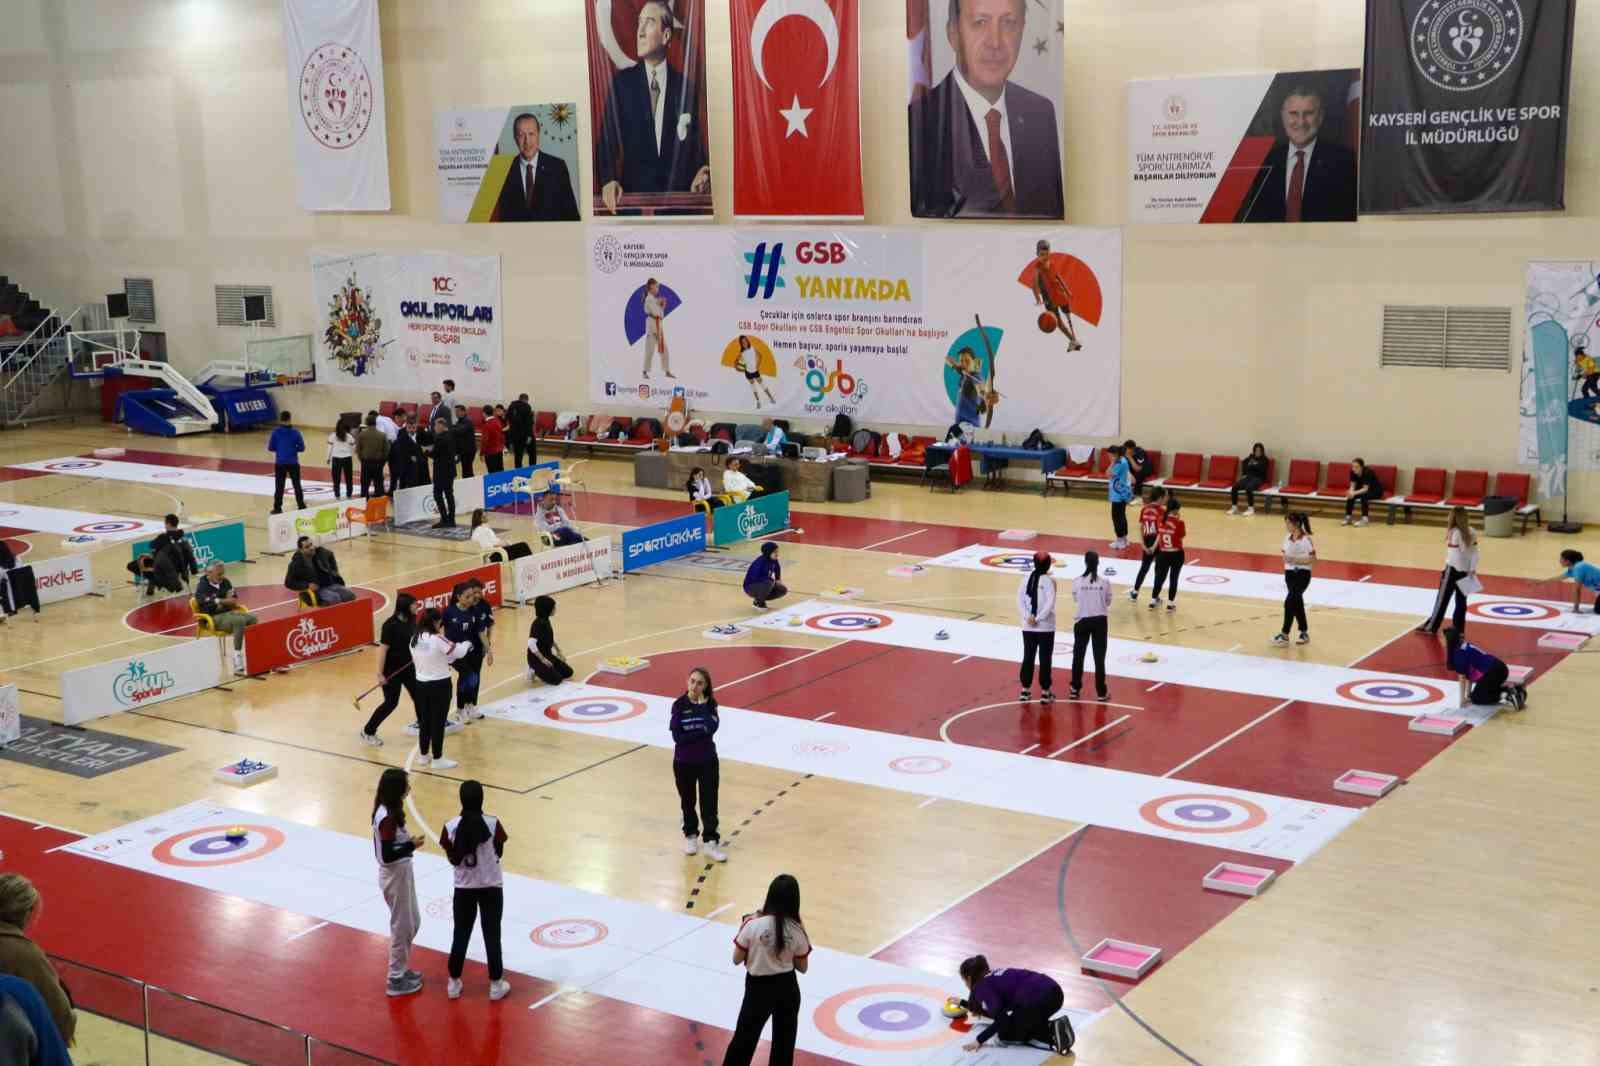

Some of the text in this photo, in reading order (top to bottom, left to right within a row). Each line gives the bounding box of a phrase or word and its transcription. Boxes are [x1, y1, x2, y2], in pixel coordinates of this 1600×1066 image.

[1369, 105, 1561, 127] KAYSERİ GENÇLİK VE SPOR
[1405, 125, 1520, 145] İL MÜDÜRLÜĞÜ
[1134, 172, 1174, 182] BAŞARILAR
[795, 240, 847, 264] GSB
[794, 275, 912, 302] YANIMDA
[400, 300, 494, 325] OKUL SPORLARI
[760, 310, 923, 325] Çocuklar için onlarca spor branşını barındıran
[753, 321, 768, 332] Spor
[433, 332, 461, 345] BAŞARI
[772, 340, 909, 355] Hemen başvur, sporla yaşamaya başla!
[1162, 533, 1174, 549] 9
